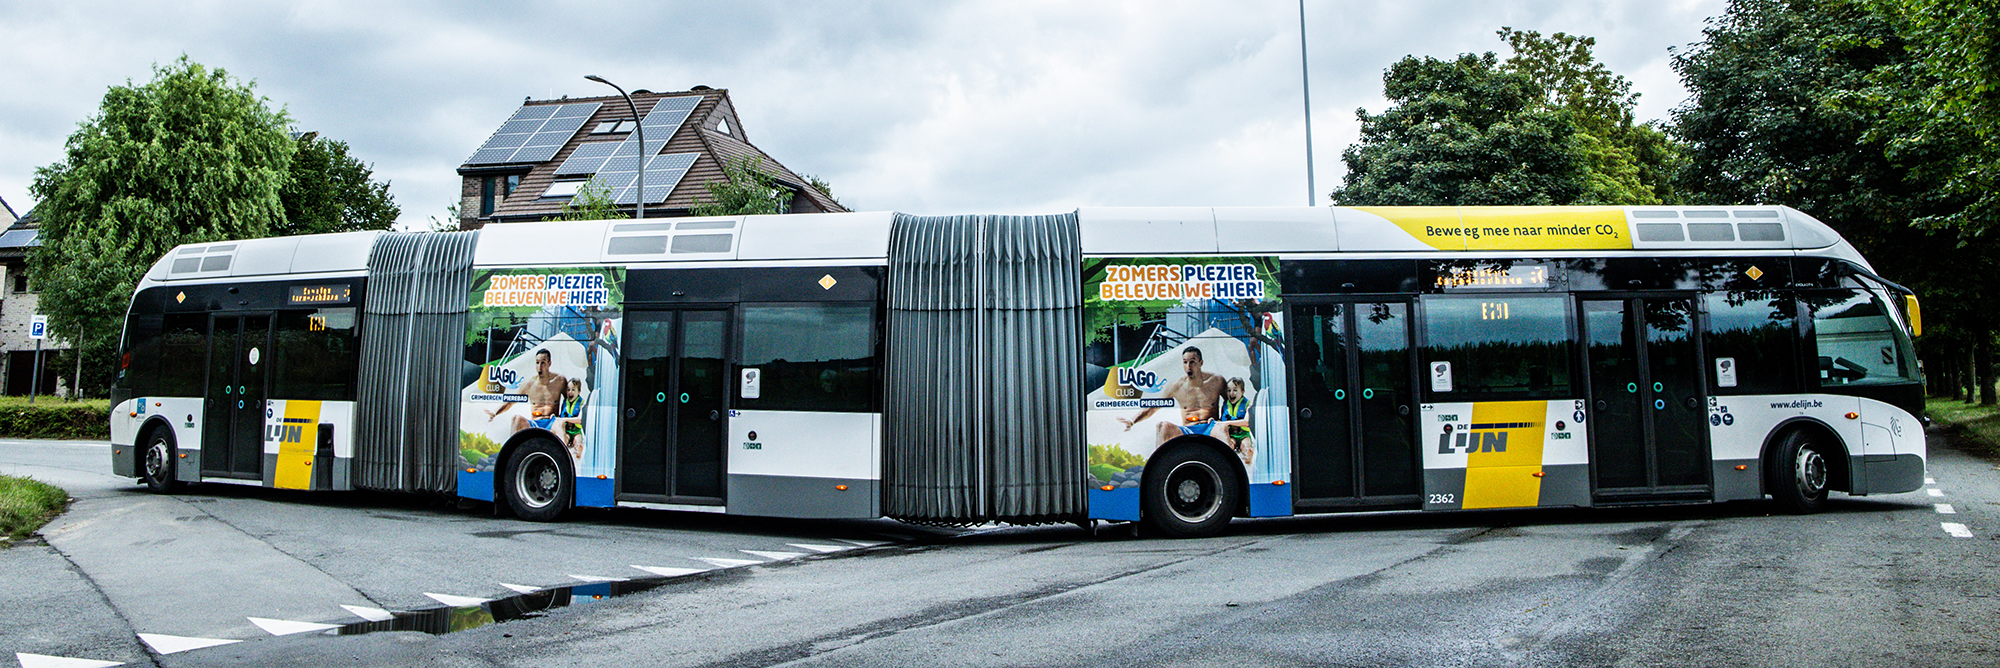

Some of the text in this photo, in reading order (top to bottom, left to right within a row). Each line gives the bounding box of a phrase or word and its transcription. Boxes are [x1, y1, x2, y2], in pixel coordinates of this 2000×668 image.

[1483, 227, 1509, 236] mee
[1513, 226, 1542, 236] naar
[1546, 224, 1591, 236] minder
[1107, 265, 1256, 282] ZOMERS PLEZIER
[491, 275, 603, 290] ZOMERS PLEZIER
[1101, 281, 1263, 299] BELEVEN WE HIER!
[485, 290, 607, 305] BELEVEN WE HIER!
[35, 323, 42, 332] P
[489, 366, 516, 385] LAGO
[1119, 368, 1156, 388] LAGO
[486, 384, 500, 392] CLUB
[1115, 388, 1135, 397] CLUB
[1095, 399, 1174, 408] GRIMBERGEN PIEREBAD
[1770, 399, 1823, 409] www.delijn.be
[265, 425, 302, 443] LIJN
[1438, 432, 1508, 454] LIJN
[1429, 493, 1454, 504] 2362
